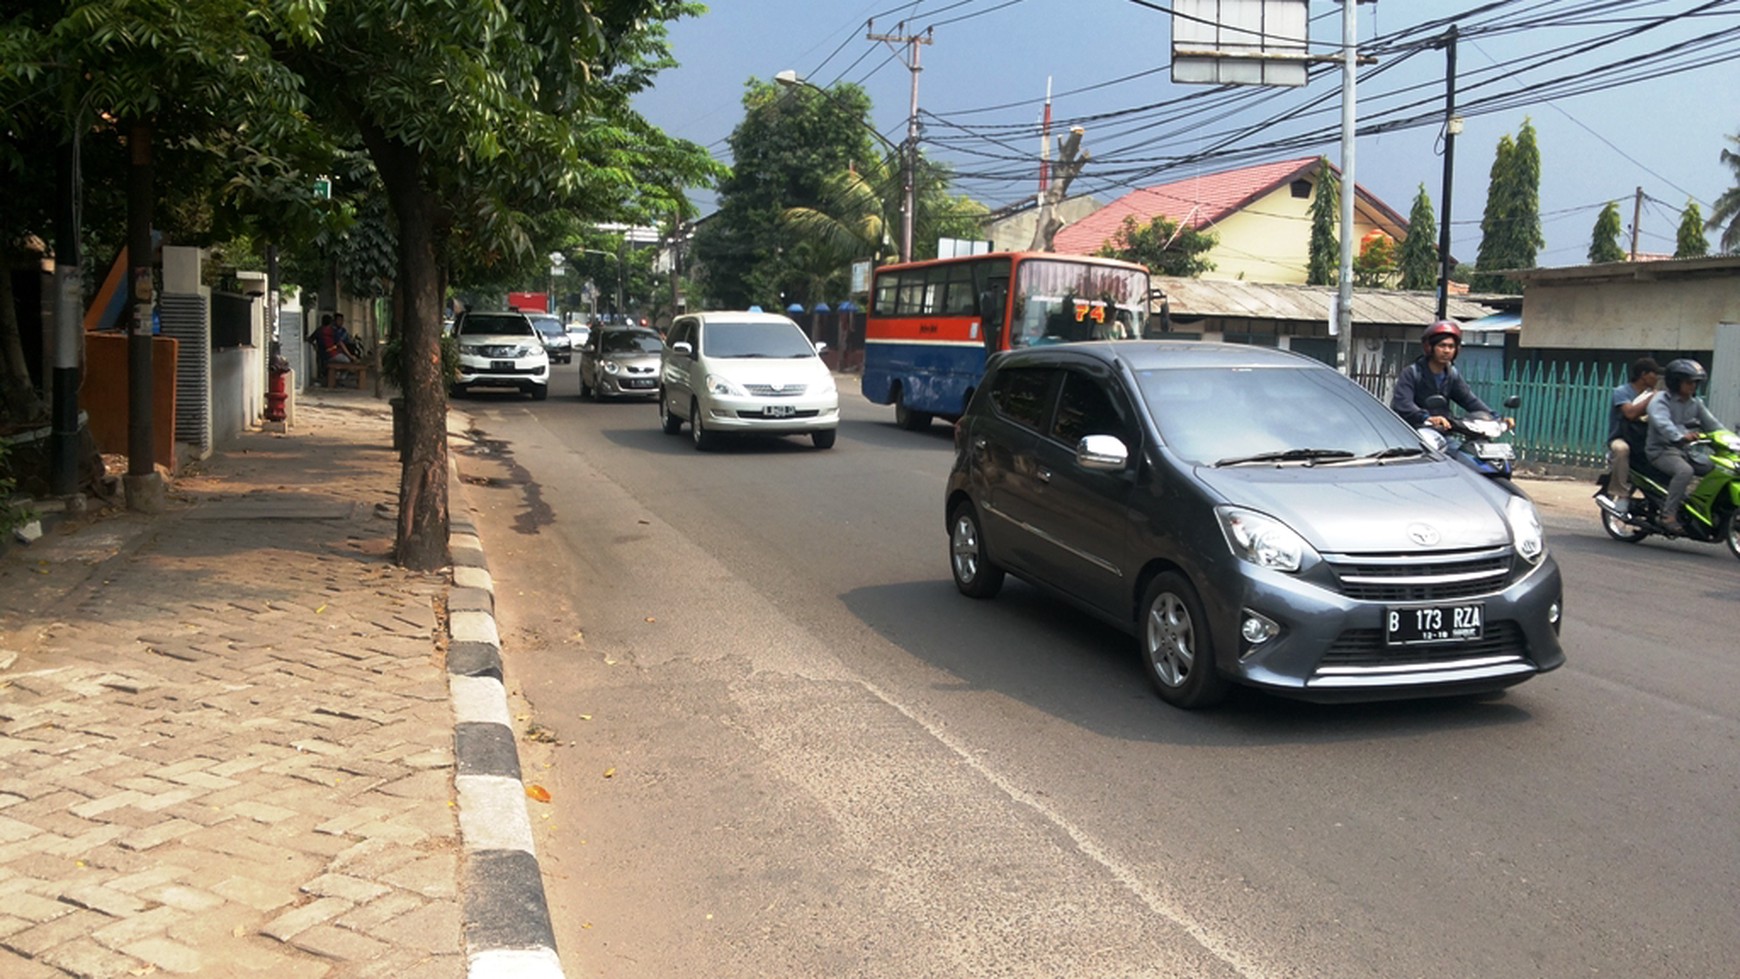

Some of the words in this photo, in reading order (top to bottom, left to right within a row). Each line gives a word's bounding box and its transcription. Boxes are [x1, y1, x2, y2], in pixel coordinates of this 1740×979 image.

[1075, 304, 1105, 324] 74
[1389, 611, 1400, 632] B
[1416, 609, 1442, 631] 173
[1453, 606, 1481, 628] RZA
